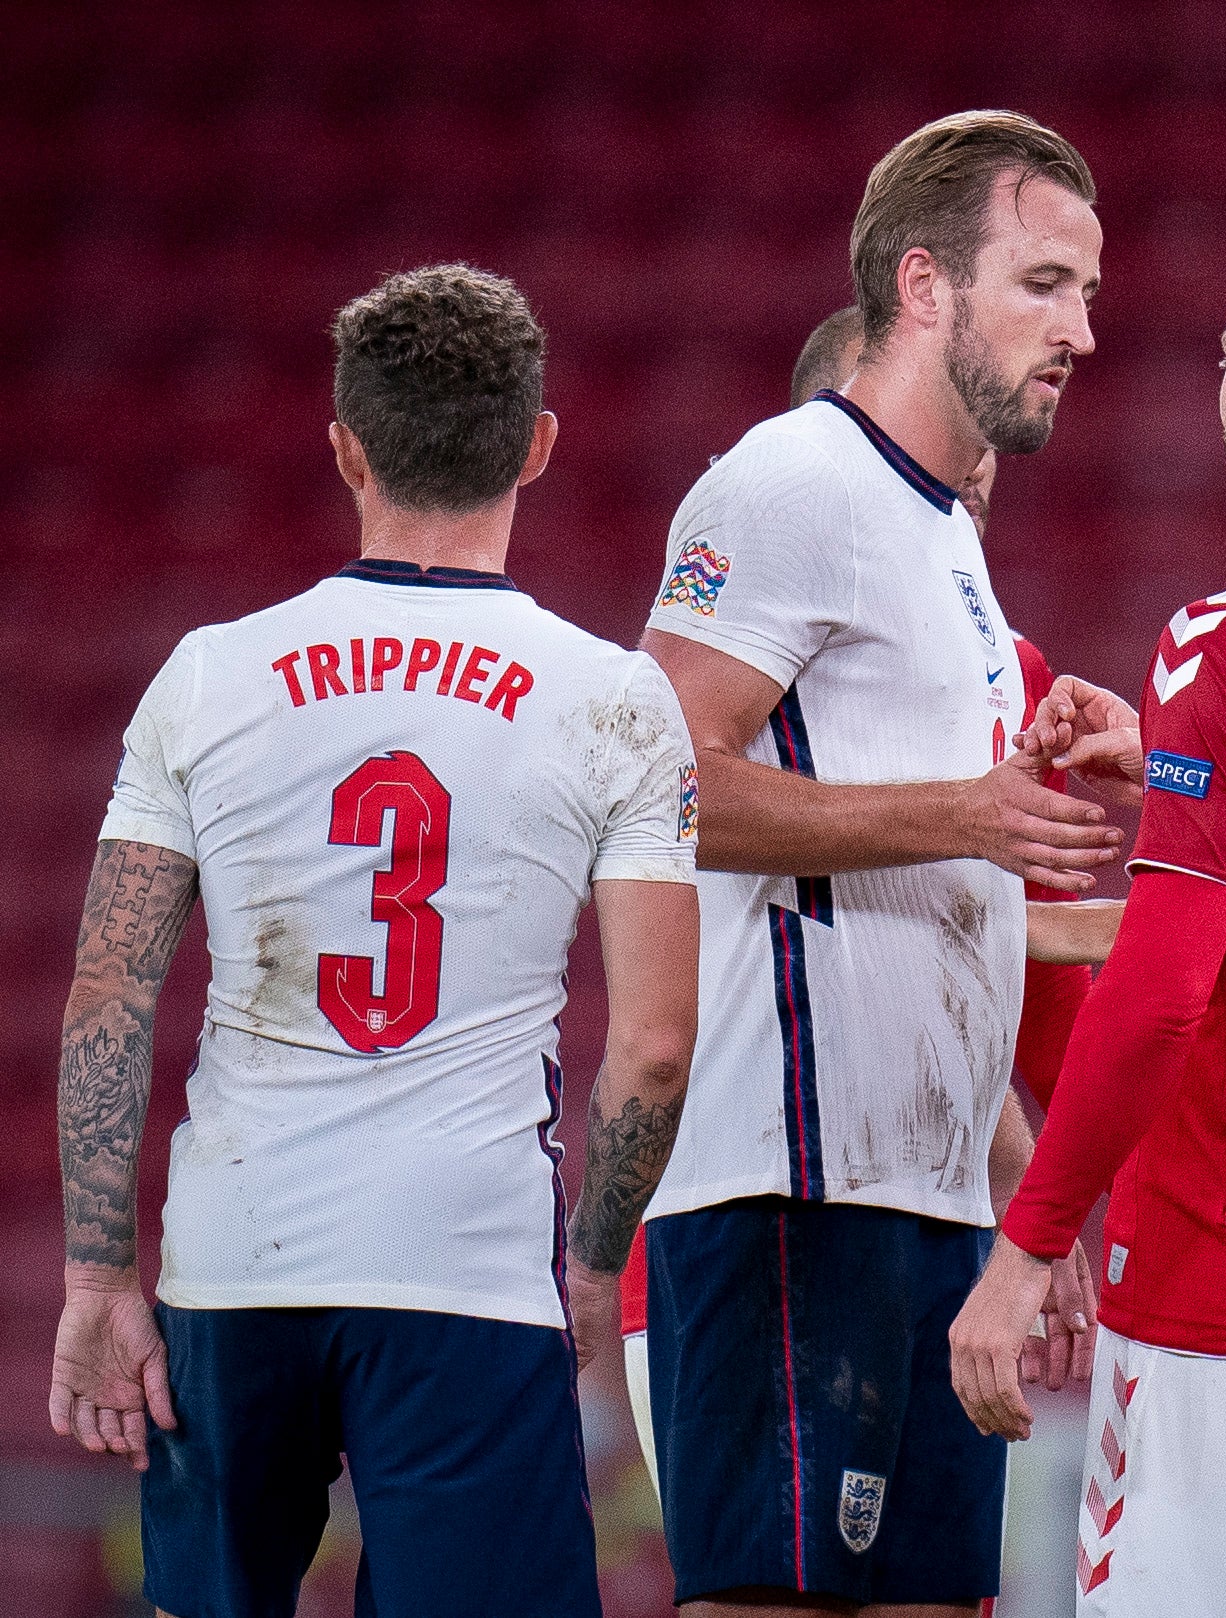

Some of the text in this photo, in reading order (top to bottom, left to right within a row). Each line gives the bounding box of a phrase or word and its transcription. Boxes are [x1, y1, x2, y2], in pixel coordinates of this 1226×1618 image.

[272, 637, 534, 722] TRIPPIER
[1149, 760, 1211, 788] SPECT
[318, 750, 451, 1054] 3
